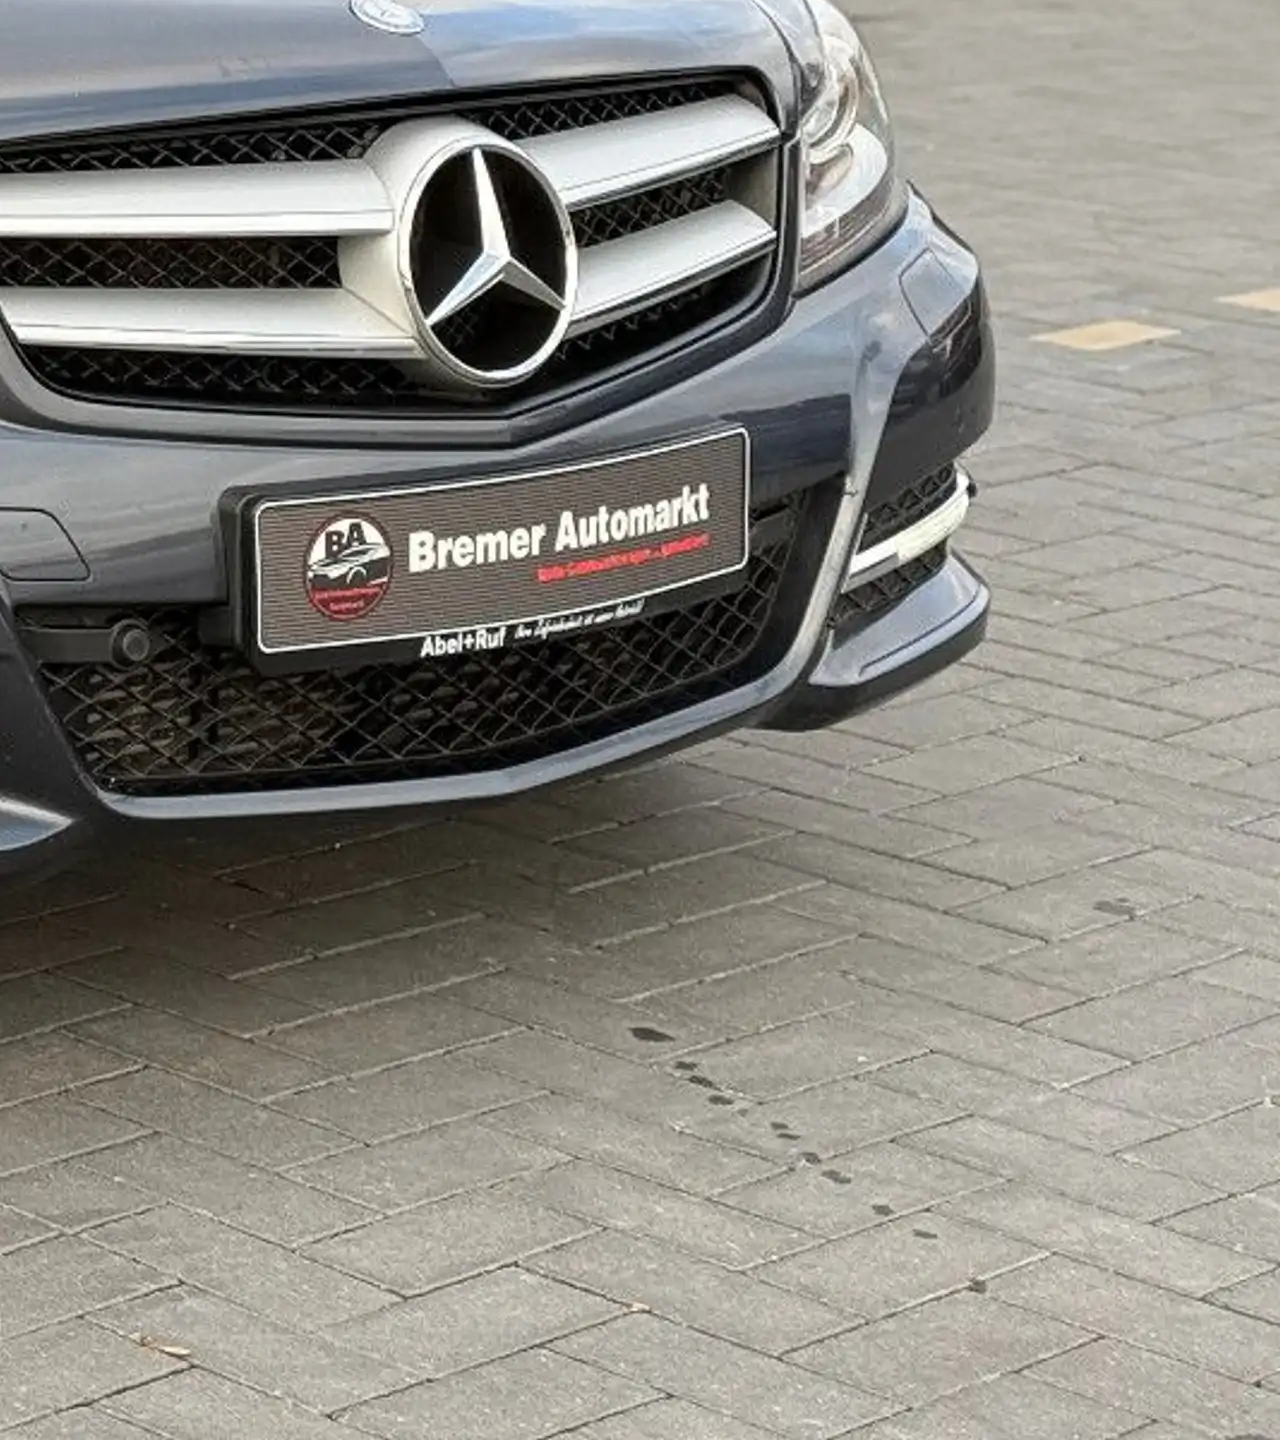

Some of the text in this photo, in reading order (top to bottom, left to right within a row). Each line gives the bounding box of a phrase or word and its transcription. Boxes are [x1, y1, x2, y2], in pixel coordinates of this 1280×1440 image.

[324, 522, 368, 559] BA
[408, 523, 546, 573] Bremer
[554, 482, 710, 552] Automarkt
[419, 626, 507, 658] Abel+Ruf
